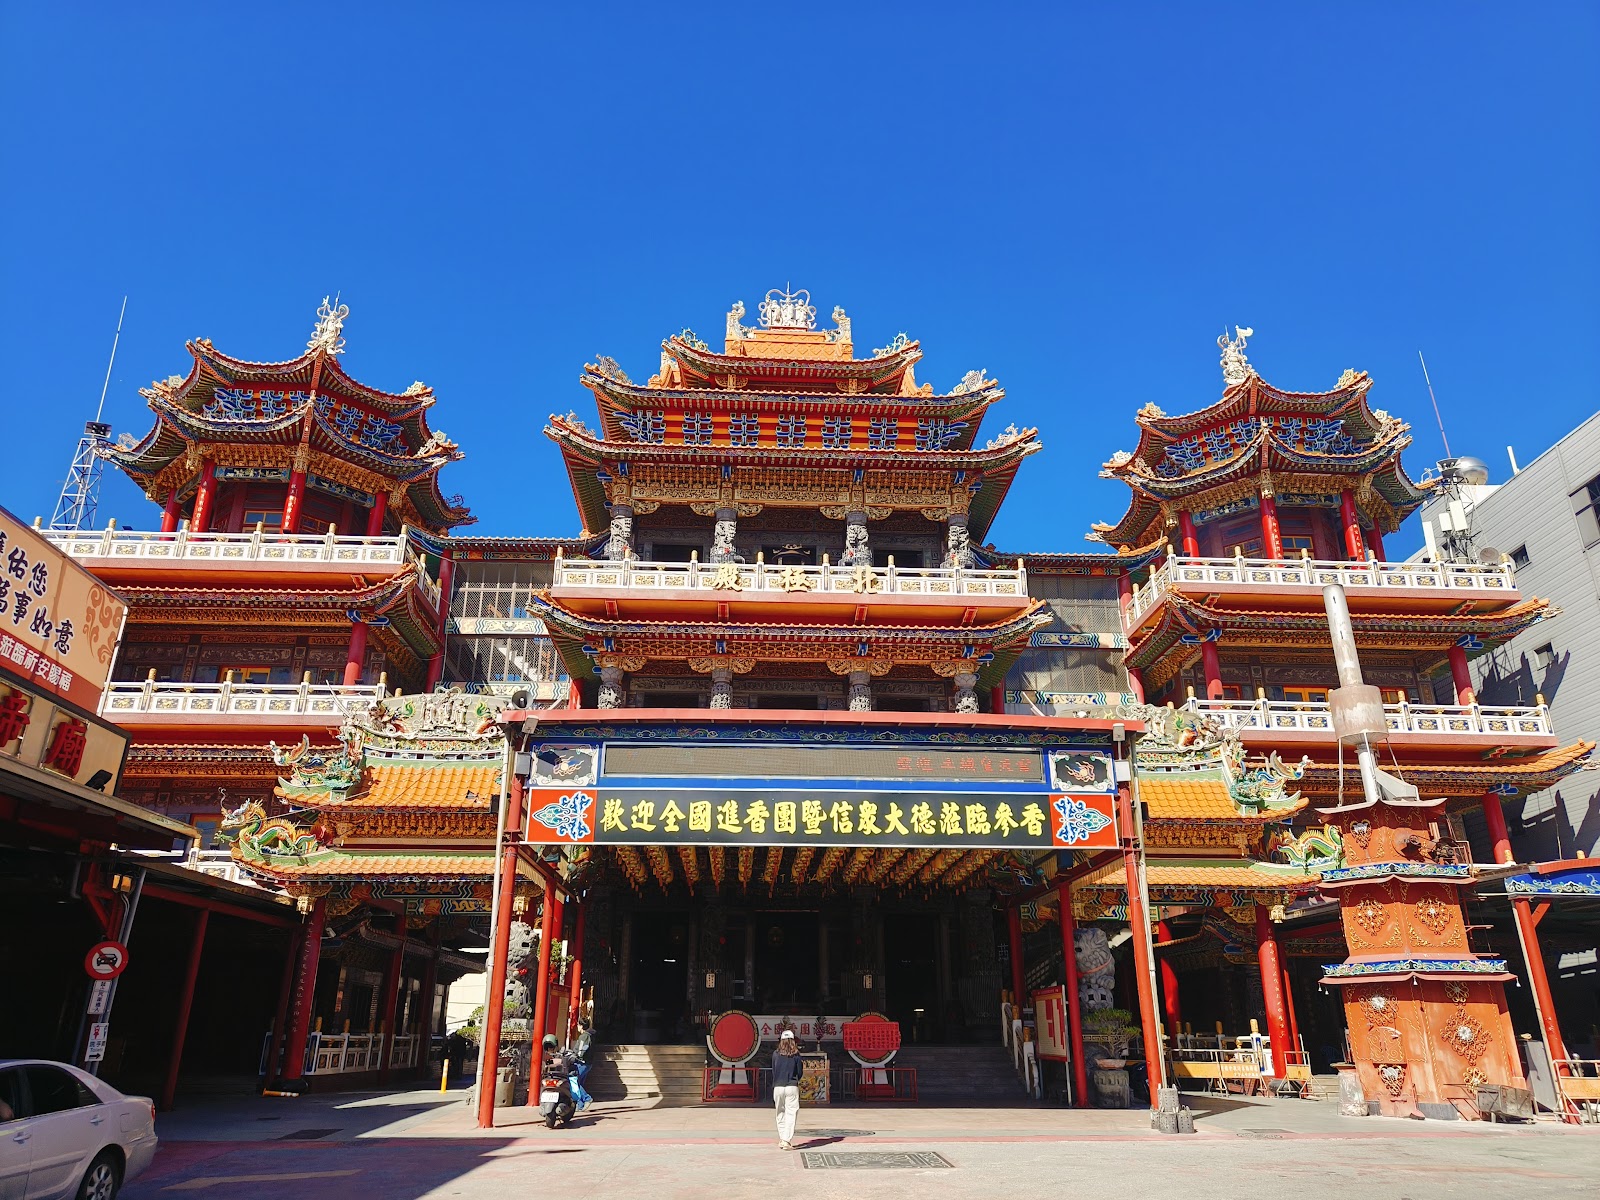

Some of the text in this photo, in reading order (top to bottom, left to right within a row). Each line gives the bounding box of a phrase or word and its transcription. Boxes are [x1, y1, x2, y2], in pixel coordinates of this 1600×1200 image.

[0, 633, 73, 692] 蒞臨祈安賜福
[0, 688, 87, 780] 帝廟
